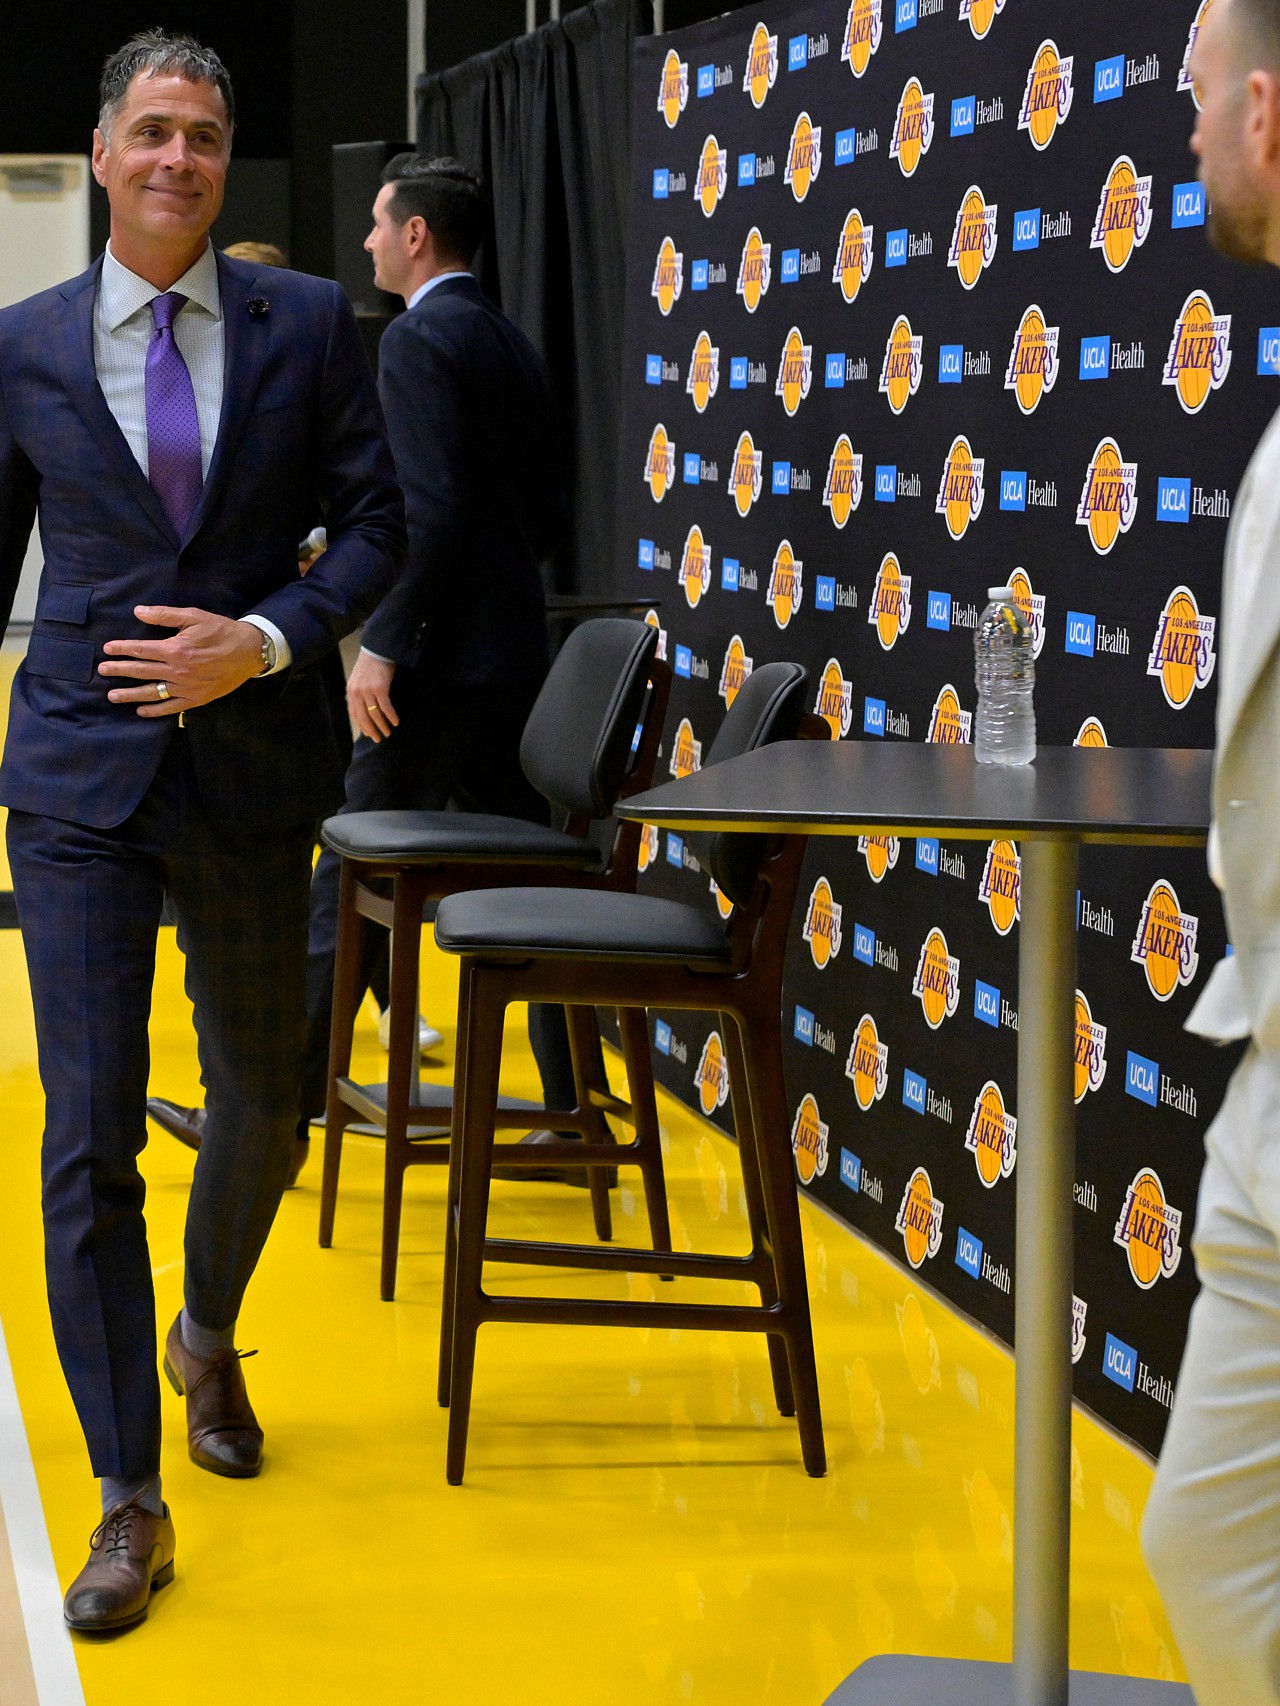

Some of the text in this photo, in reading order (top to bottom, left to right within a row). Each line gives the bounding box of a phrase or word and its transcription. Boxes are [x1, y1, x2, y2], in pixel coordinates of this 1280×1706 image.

[898, 0, 943, 23] UCLA Health
[791, 44, 805, 62] UCLA
[808, 33, 828, 59] Health
[845, 12, 879, 54] LAKERS
[700, 73, 712, 89] UCLA
[745, 47, 775, 86] LAKERS
[1047, 62, 1070, 78] ANGELES
[1098, 67, 1119, 91] UCLA
[1125, 54, 1159, 87] Health
[954, 97, 1003, 126] UCLA Health
[1021, 72, 1069, 123] LAKERS
[838, 128, 878, 156] UCLA Health
[892, 106, 930, 152] LAKERS
[740, 155, 774, 178] UCLA Health
[786, 138, 818, 179] LAKERS
[655, 176, 667, 191] UCLA
[1123, 182, 1149, 196] ANGELES
[974, 210, 994, 221] ANGELES
[1094, 189, 1147, 242] LAKERS
[1177, 194, 1201, 216] UCLA
[950, 215, 993, 261] LAKERS
[1017, 211, 1071, 240] UCLA Health
[835, 235, 870, 277] LAKERS
[889, 232, 932, 257] UCLA Health
[694, 268, 706, 282] UCLA
[738, 251, 768, 289] LAKERS
[784, 251, 820, 274] UCLA Health
[1034, 333, 1056, 343] ANGELES
[1199, 322, 1227, 333] ANGELES
[881, 343, 919, 388] LAKERS
[942, 351, 990, 375] UCLA Health
[1007, 335, 1055, 386] LAKERS
[1084, 342, 1144, 369] UCLA Health
[1166, 324, 1226, 381] LAKERS
[1263, 339, 1280, 363] UC
[648, 362, 660, 376] UCLA
[733, 362, 766, 383] UCLA Health
[777, 351, 809, 393] LAKERS
[828, 358, 867, 381] UCLA Health
[686, 461, 698, 476] UCLA
[730, 453, 759, 496] LAKERS
[775, 468, 810, 490] UCLA Health
[825, 459, 859, 504] LAKERS
[961, 464, 981, 472] ANGELES
[1109, 470, 1134, 478] ANGELES
[878, 473, 920, 496] UCLA Health
[938, 463, 980, 514] LAKERS
[1004, 480, 1057, 506] UCLA Health
[1079, 468, 1133, 525] LAKERS
[1162, 487, 1230, 518] UCLA Health
[640, 547, 652, 562] UCLA
[724, 566, 736, 582] UCLA
[739, 567, 757, 590] Health
[768, 562, 799, 608] LAKERS
[818, 584, 857, 607] UCLA Health
[870, 577, 908, 628] LAKERS
[1021, 598, 1043, 608] ANGELES
[931, 601, 978, 628] UCLA Health
[1183, 621, 1211, 631] ANGELES
[1070, 622, 1090, 645] UCLA
[1096, 625, 1129, 654] Health
[1151, 616, 1210, 681] LAKERS
[677, 653, 689, 670] UCLA
[818, 680, 849, 731] LAKERS
[867, 706, 910, 737] UCLA Health
[919, 842, 936, 864] UCLA
[940, 848, 965, 879] Health
[981, 852, 1020, 914] LAKER
[805, 897, 839, 952] LAKERS
[1081, 900, 1114, 936] Health
[1166, 915, 1194, 931] ANGELES
[856, 933, 898, 971] UCLA Health
[1135, 906, 1192, 978] LAKERS
[915, 949, 956, 1011] LAKERS
[938, 957, 957, 971] ANGELES
[978, 991, 1020, 1031] UCLA Heal
[797, 1015, 835, 1053] UCLA Health
[1078, 1022, 1104, 1040] ANGELES
[848, 1034, 885, 1094] LAKERS
[1075, 1034, 1102, 1084] ERS
[906, 1079, 952, 1124] UCLA Health
[1130, 1063, 1197, 1118] UCLA Health
[968, 1102, 1012, 1171] LAKERS
[993, 1113, 1013, 1130] ANGELES
[791, 1111, 825, 1171] LAKERS
[843, 1156, 883, 1204] UCLA Health
[1072, 1181, 1097, 1213] ealth
[898, 1186, 939, 1252] LAKERS
[1150, 1204, 1178, 1225] ANGELES
[1117, 1191, 1177, 1271] LAKERS
[960, 1238, 1011, 1294] UCLA Health
[1108, 1345, 1174, 1410] UCLA Health
